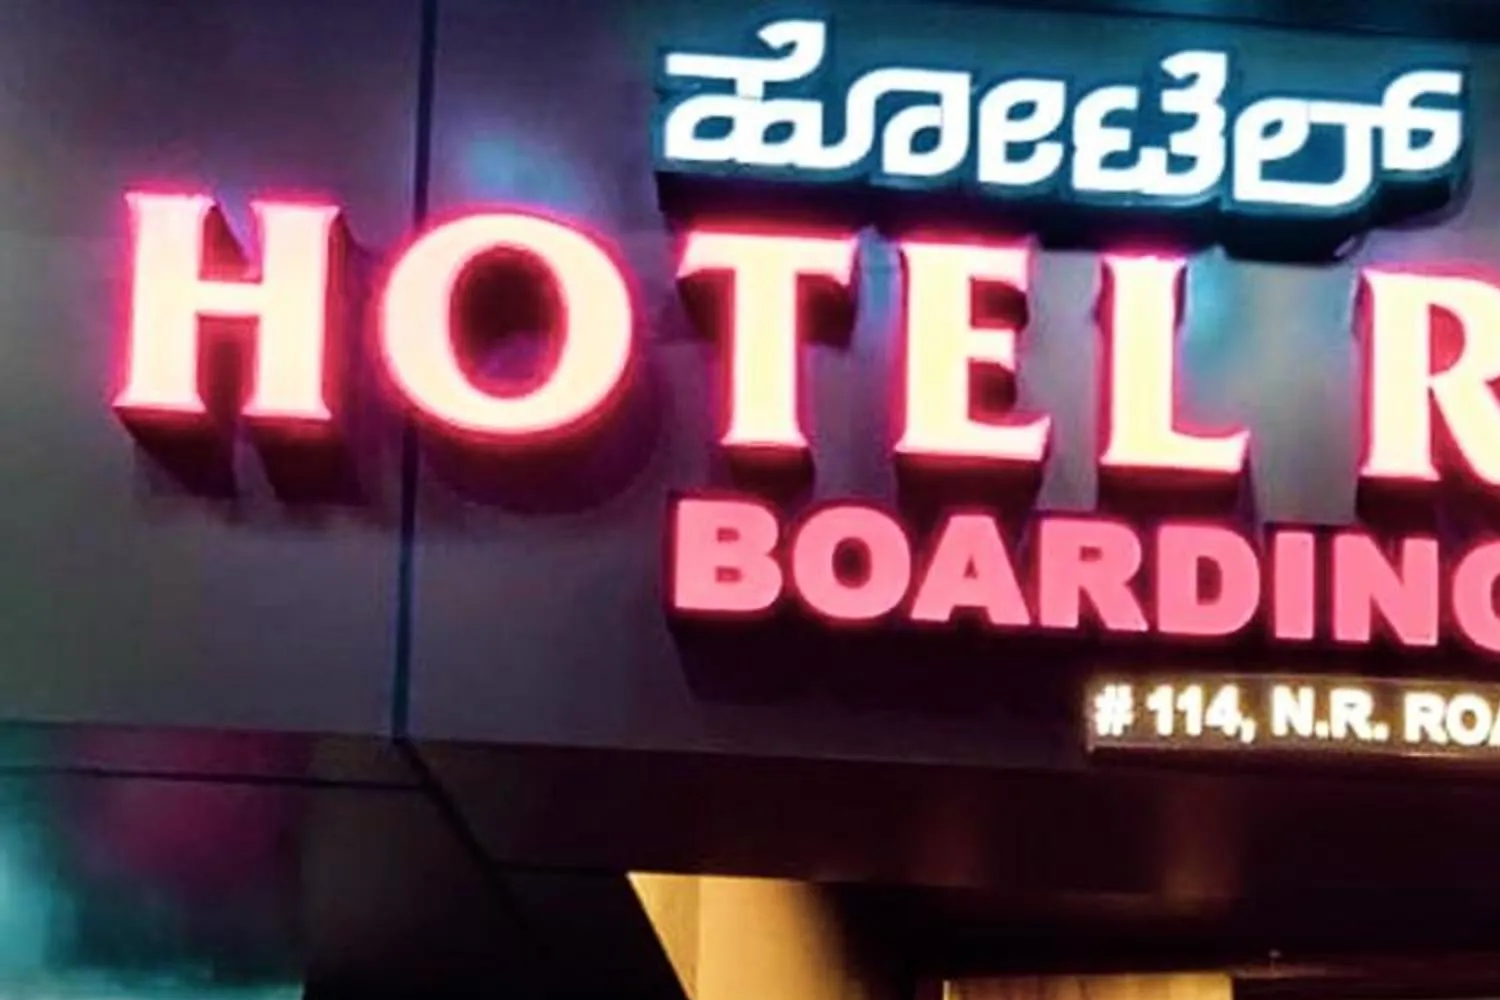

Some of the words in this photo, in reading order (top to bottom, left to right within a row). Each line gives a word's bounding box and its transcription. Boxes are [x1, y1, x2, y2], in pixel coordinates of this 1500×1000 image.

[664, 20, 1462, 210] ಹೋಟೆಲ್
[112, 192, 1250, 474] HOTEL
[1095, 684, 1134, 736] #
[1147, 685, 1255, 744] 114,
[1270, 686, 1389, 740] N.R.
